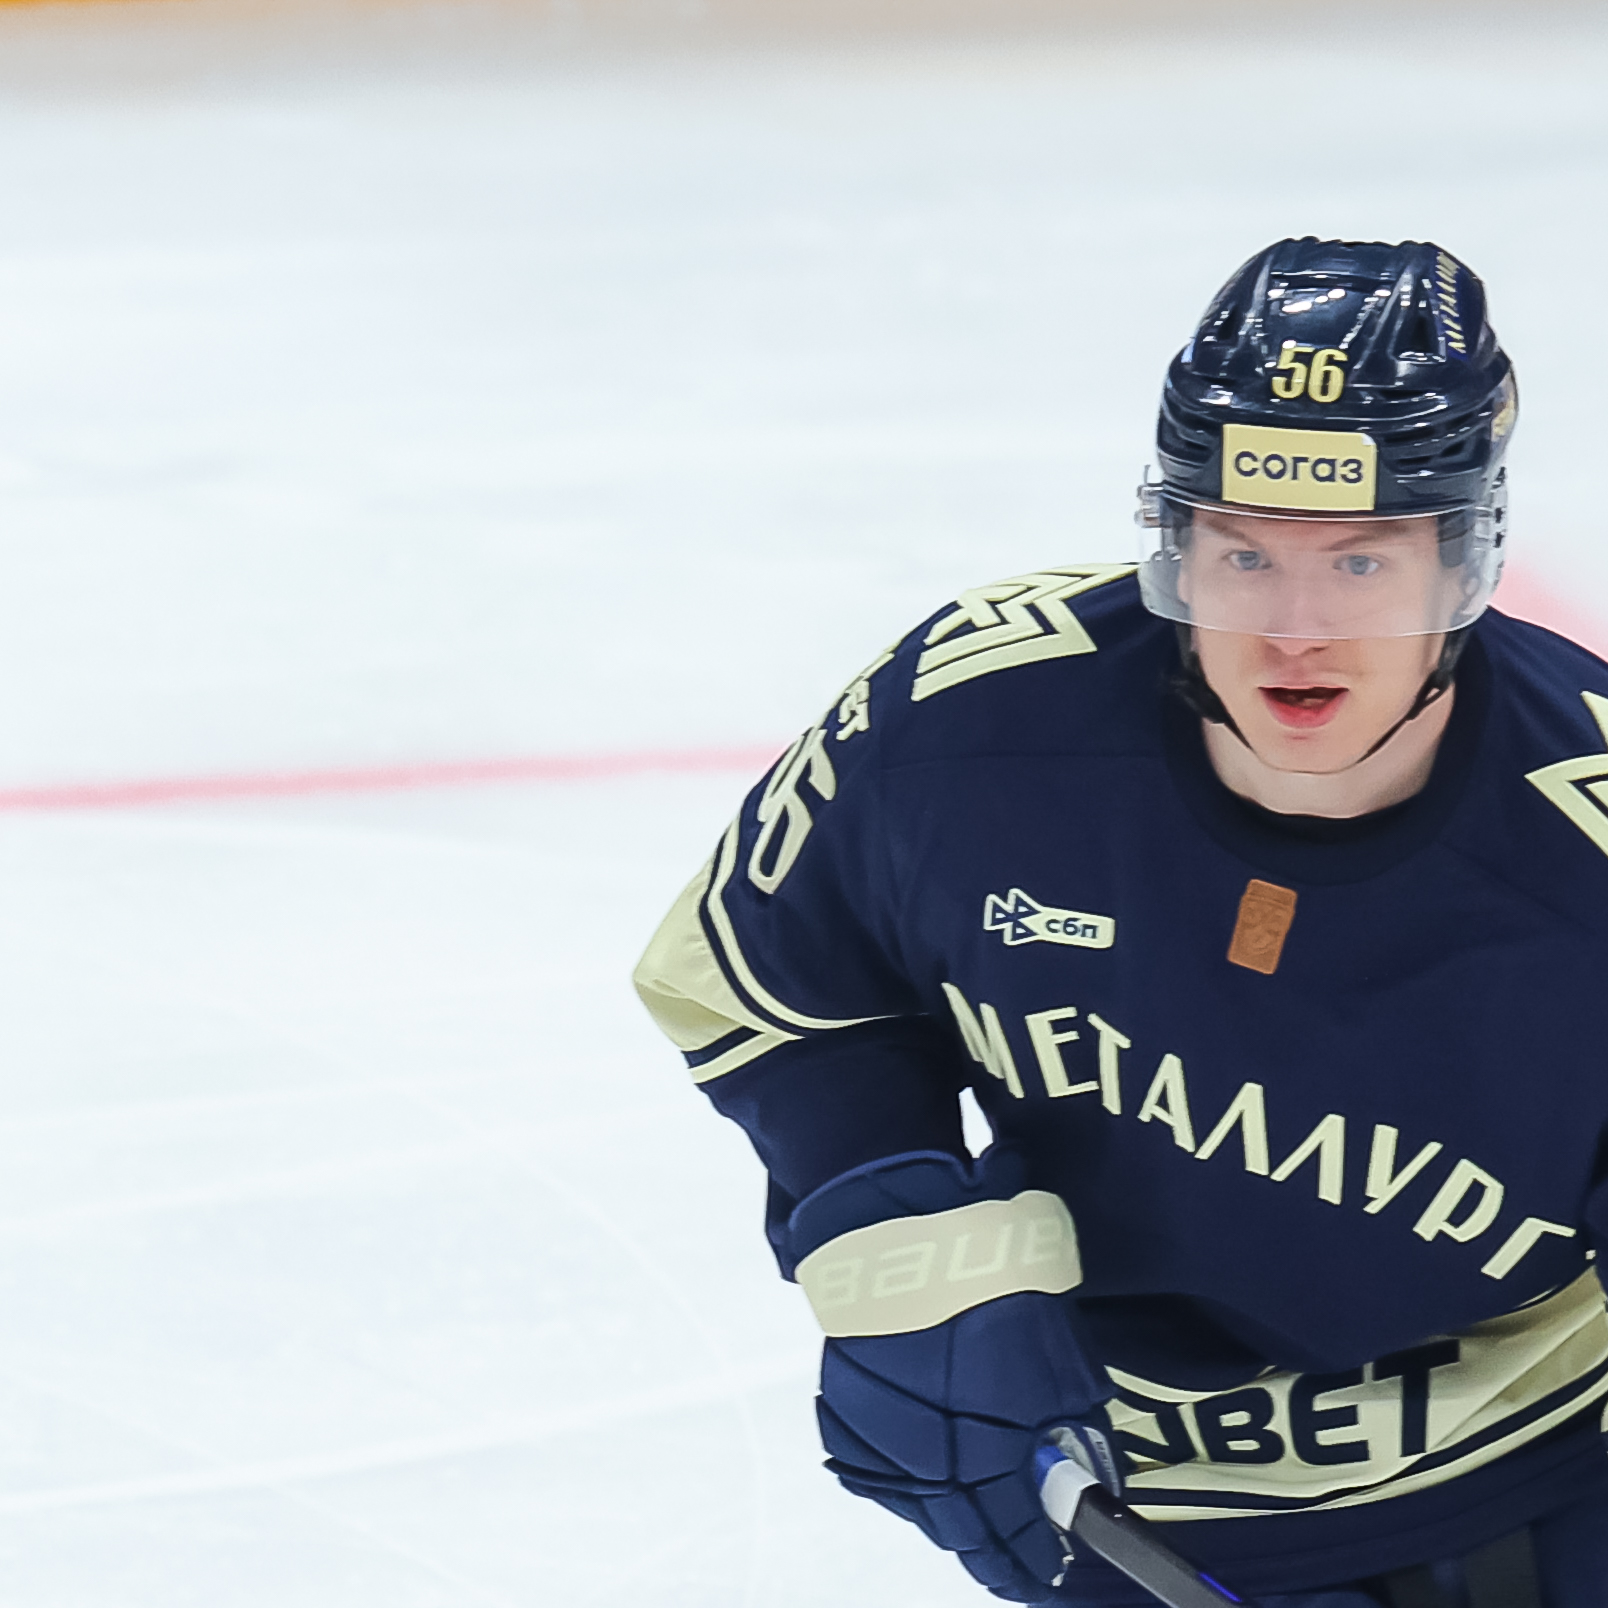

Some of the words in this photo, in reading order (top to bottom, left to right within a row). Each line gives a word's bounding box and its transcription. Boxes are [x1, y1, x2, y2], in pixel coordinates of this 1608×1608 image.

[1272, 347, 1348, 402] 56
[1234, 451, 1364, 484] согаз
[1045, 917, 1100, 939] сбп
[941, 982, 1577, 1280] МЕТАЛЛУРГ
[815, 1216, 1066, 1308] BAUE
[1104, 1339, 1461, 1470] NBET
